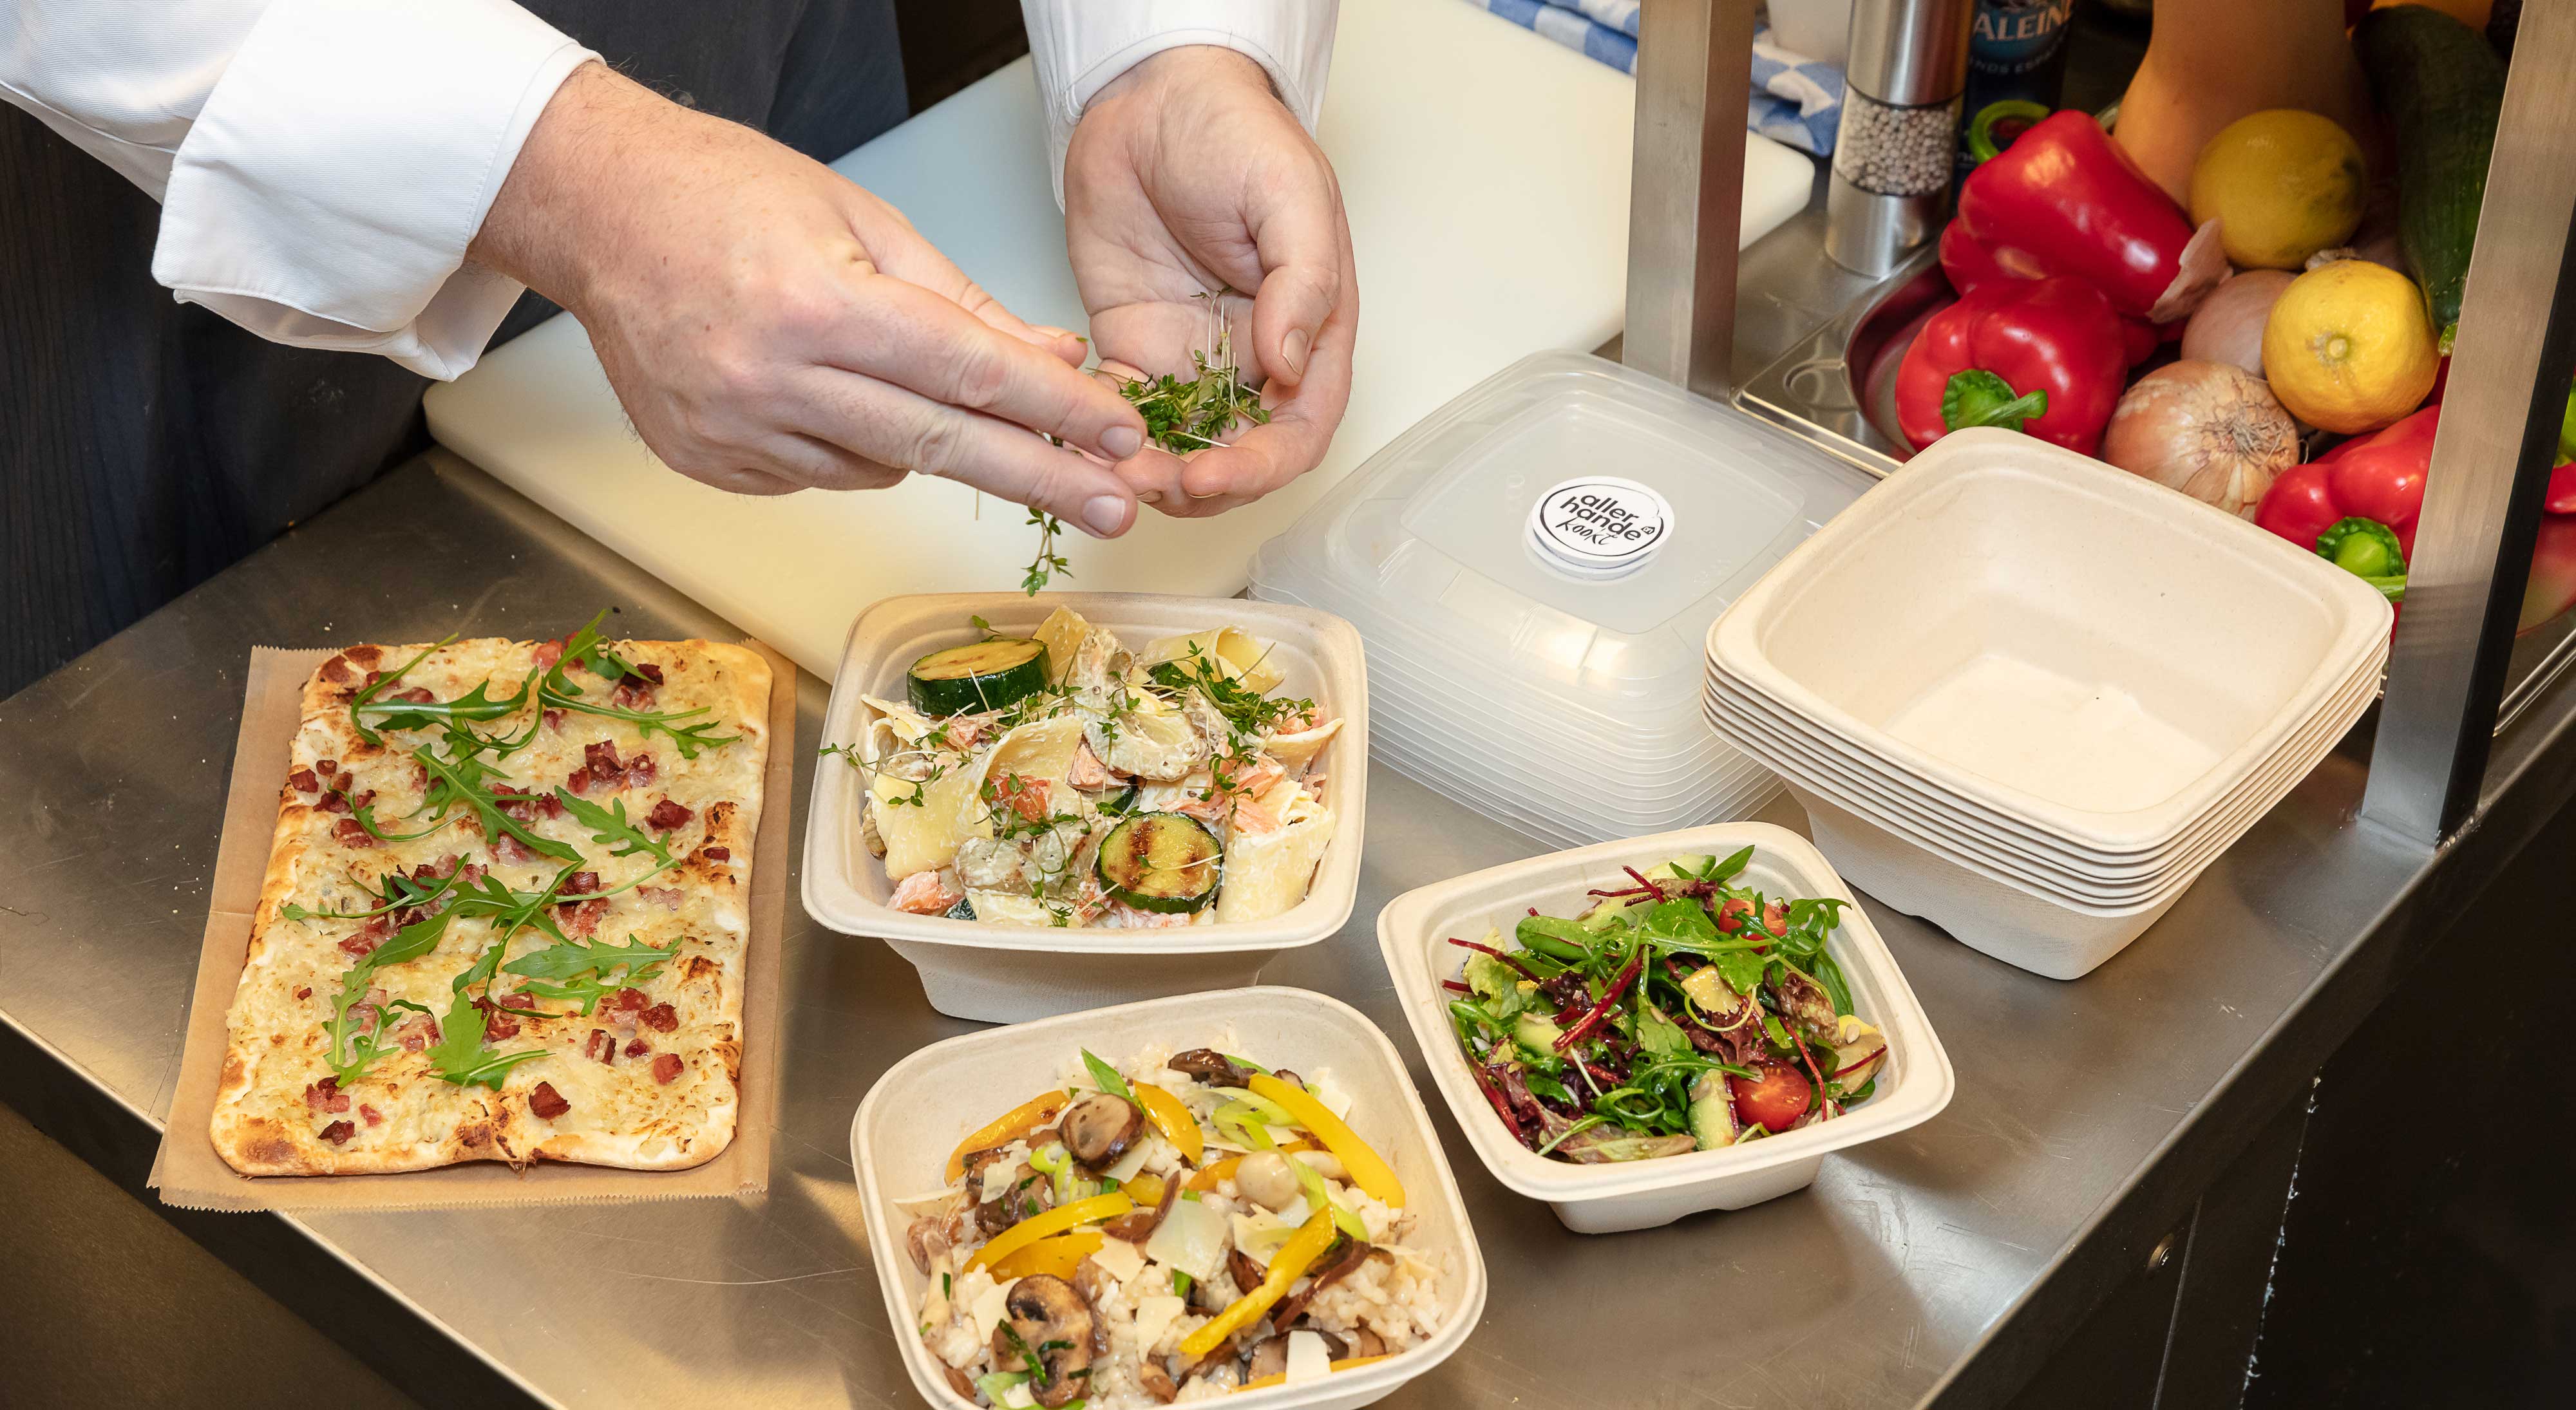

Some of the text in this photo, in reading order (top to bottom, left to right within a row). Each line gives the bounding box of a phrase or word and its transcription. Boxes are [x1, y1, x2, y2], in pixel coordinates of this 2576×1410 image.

[1560, 496, 1642, 540] hande
[1580, 495, 1640, 522] aller
[1555, 516, 1618, 545] kookt
